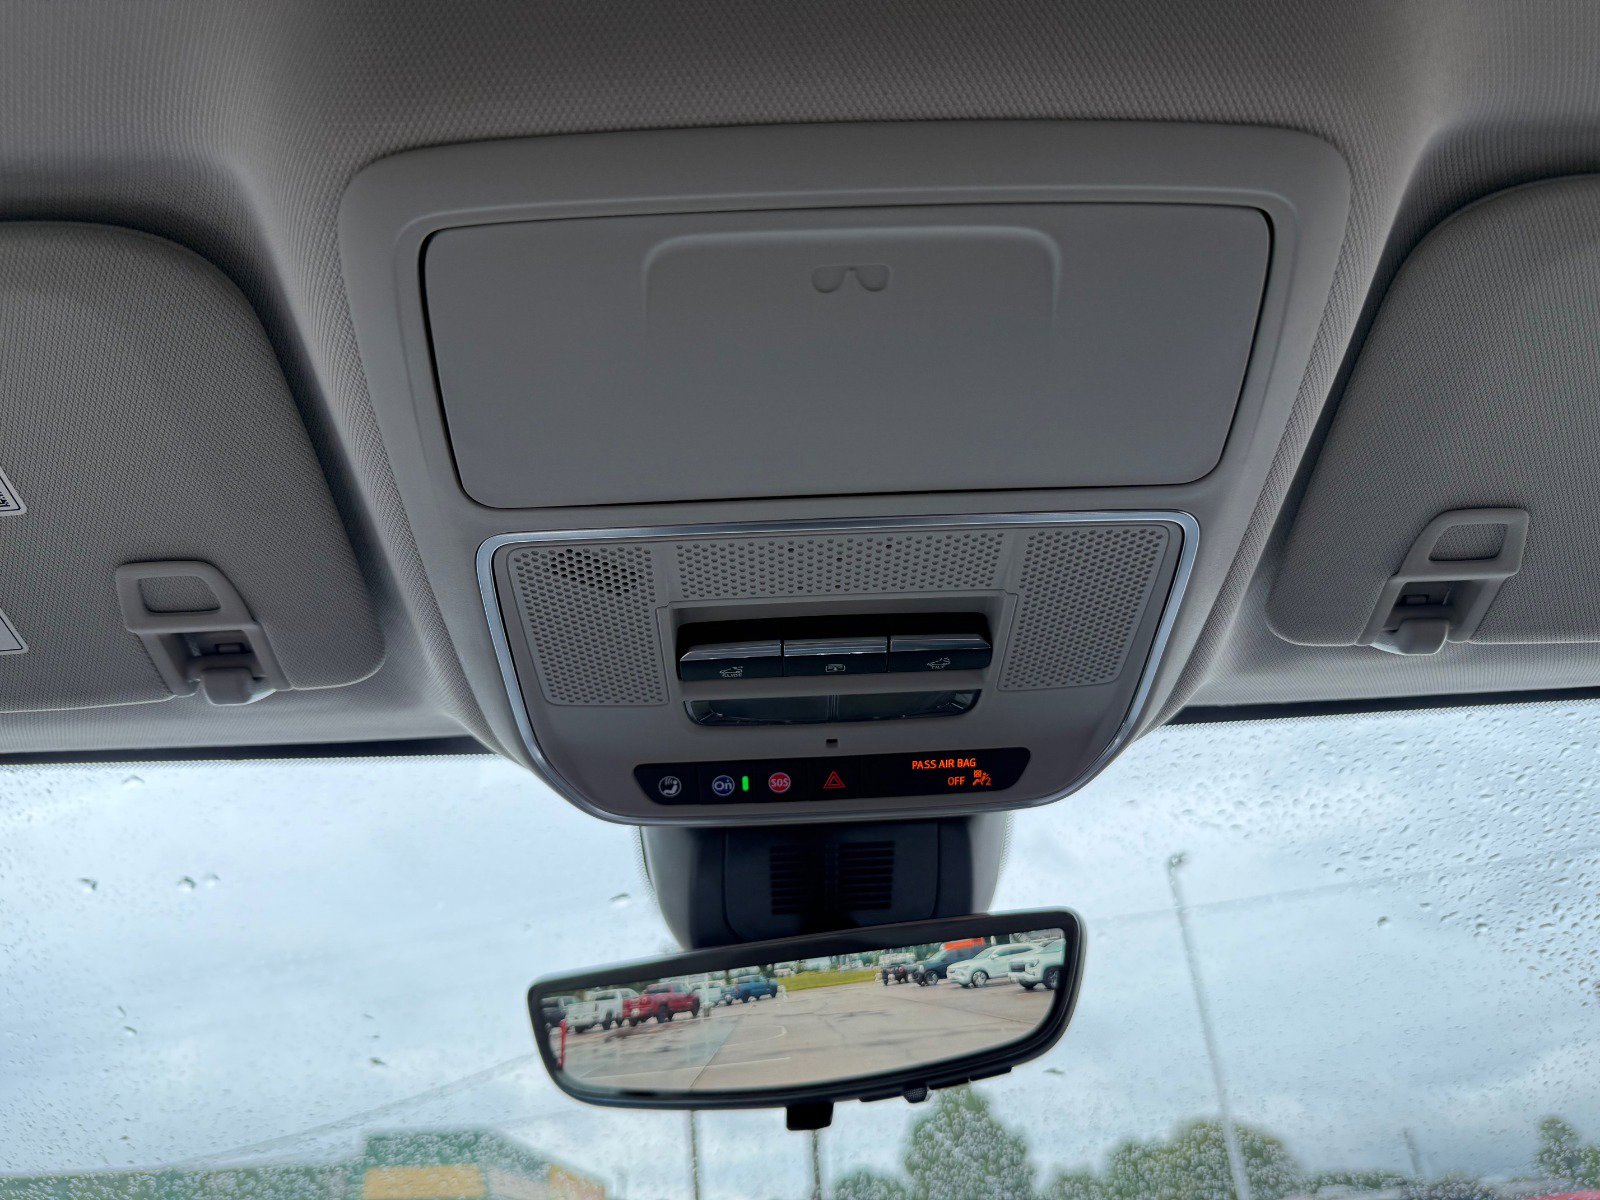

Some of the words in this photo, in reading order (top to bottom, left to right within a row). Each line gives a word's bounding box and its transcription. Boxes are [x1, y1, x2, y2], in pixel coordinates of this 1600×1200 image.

[911, 760, 937, 769] PASS
[938, 759, 955, 768] AIR
[957, 758, 976, 768] BAG
[714, 779, 733, 790] On
[771, 778, 789, 787] SOS
[947, 776, 965, 786] OFF
